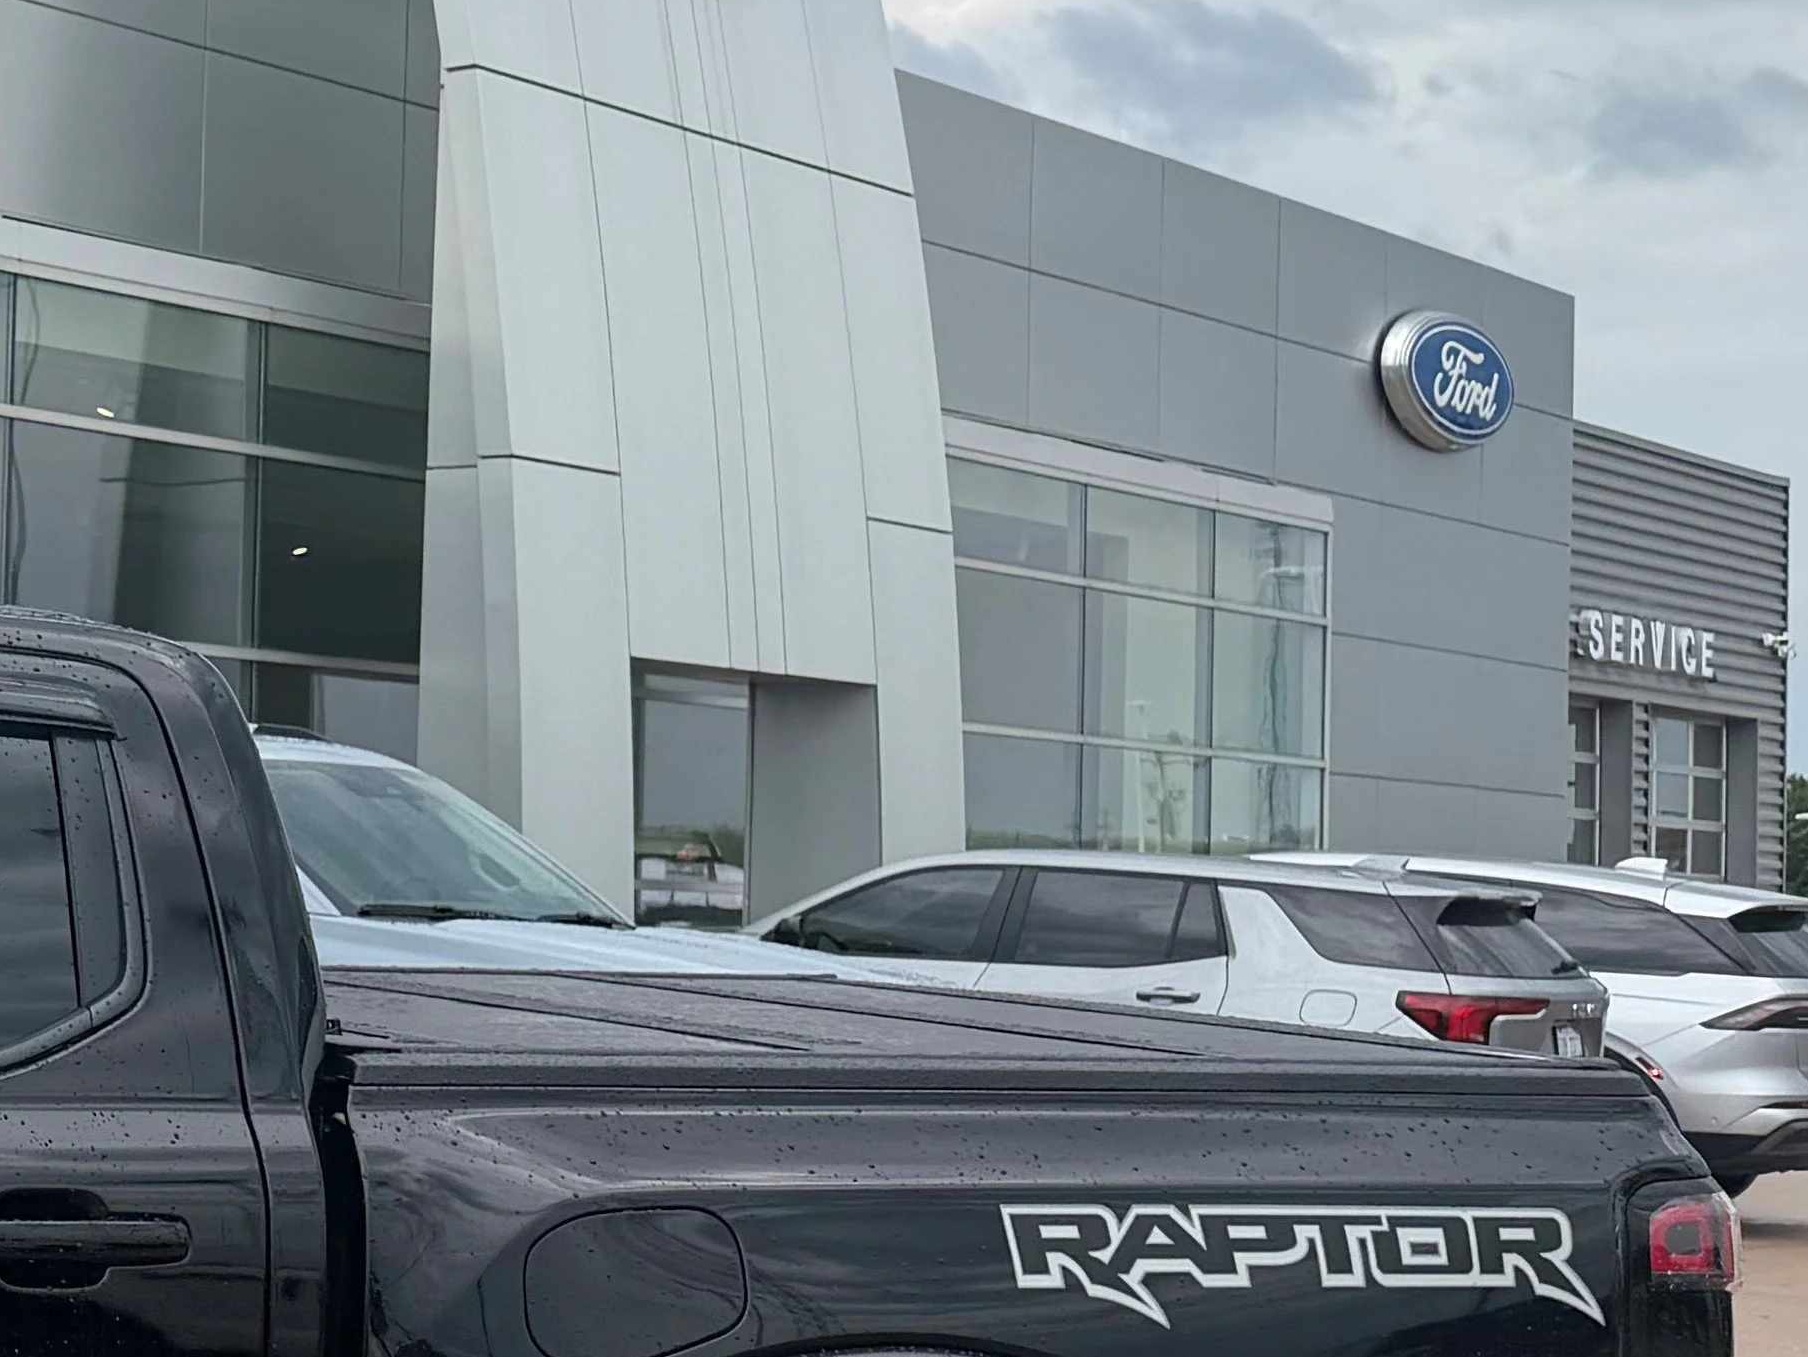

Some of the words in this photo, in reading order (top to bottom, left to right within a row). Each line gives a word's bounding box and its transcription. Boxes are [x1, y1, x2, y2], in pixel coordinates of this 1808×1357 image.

[1433, 340, 1499, 421] Ford
[1581, 609, 1716, 678] SERVICE
[1000, 1204, 1605, 1328] RAPTOR
